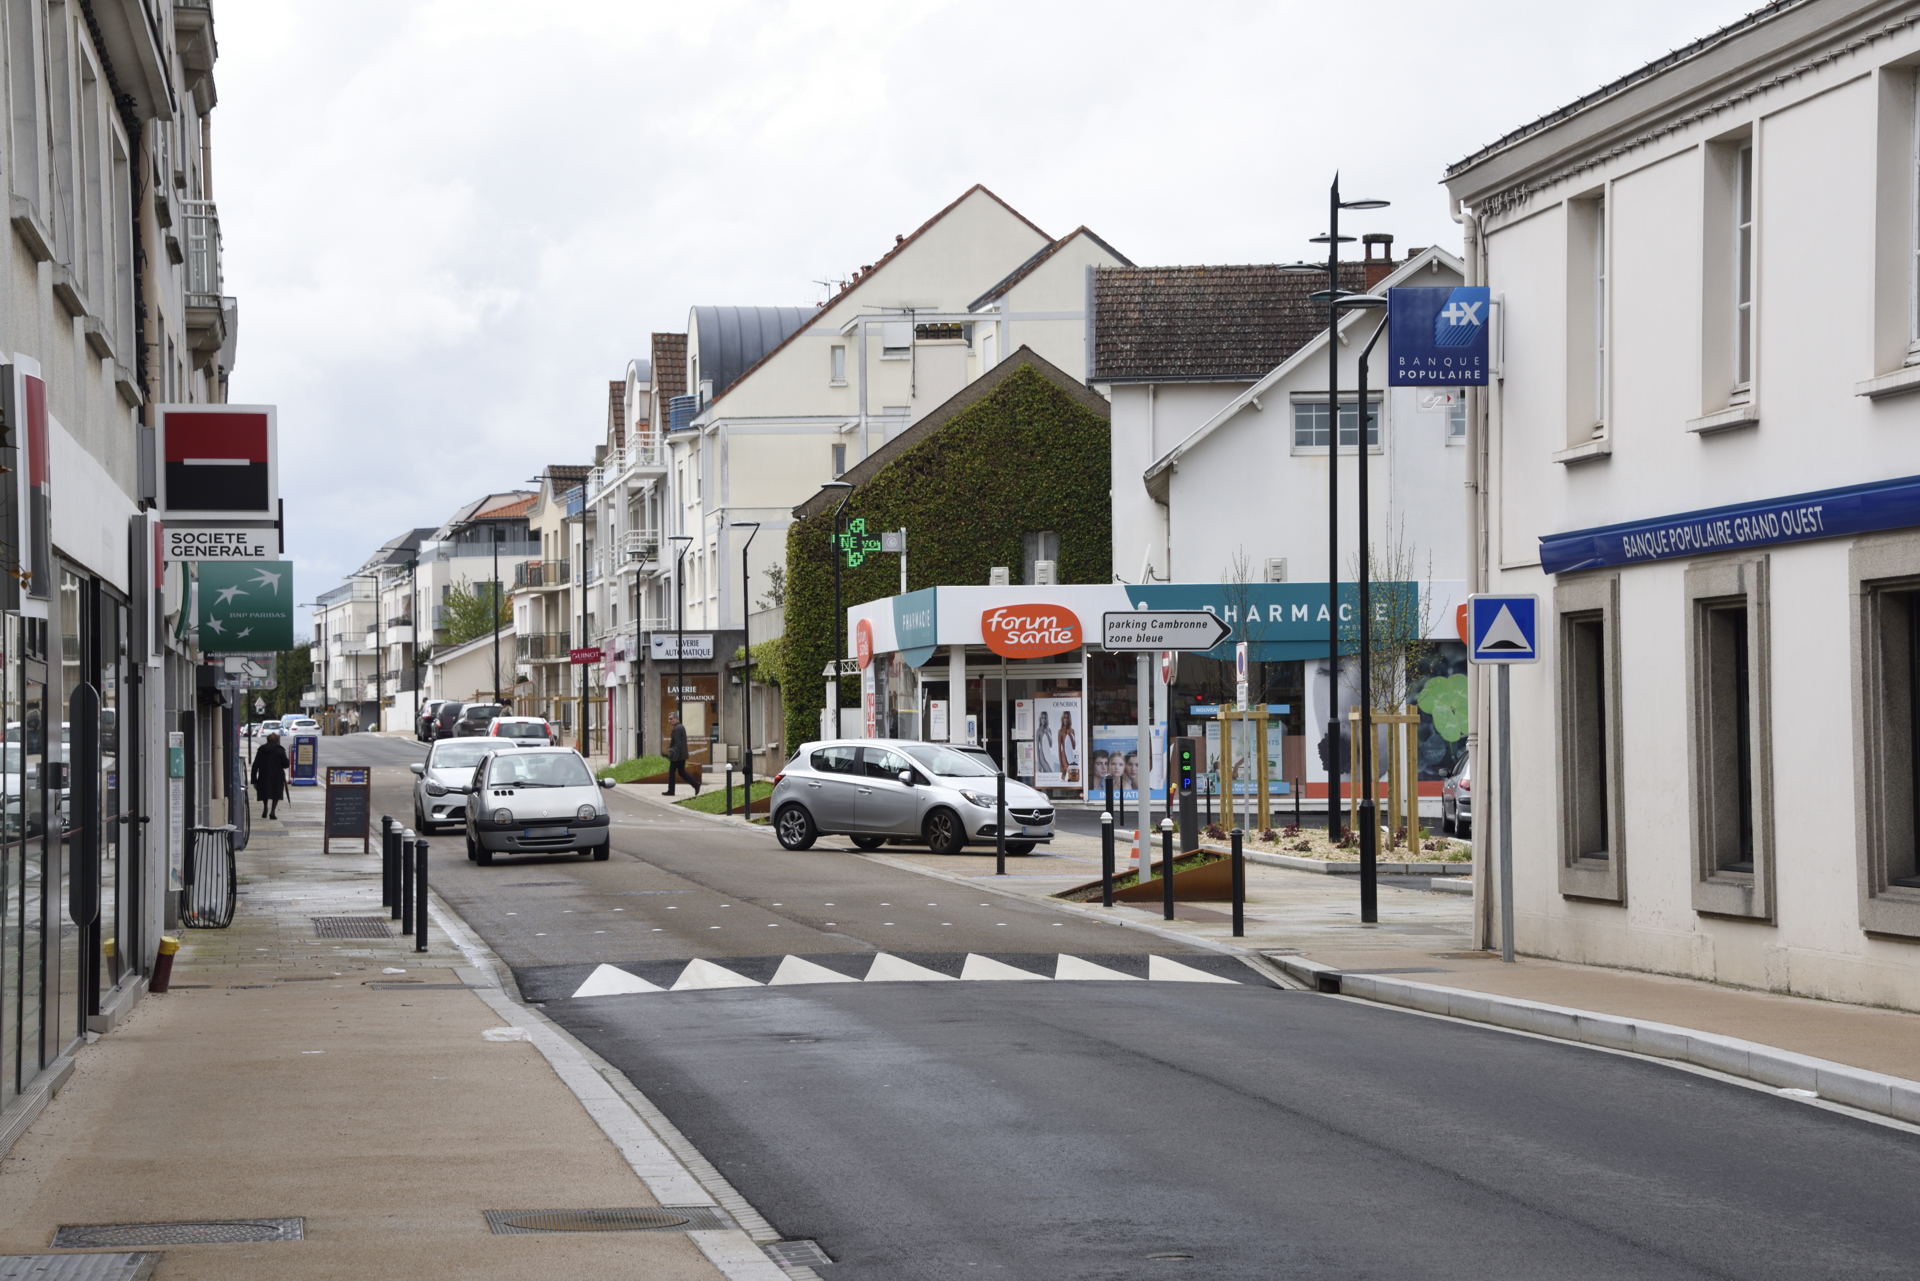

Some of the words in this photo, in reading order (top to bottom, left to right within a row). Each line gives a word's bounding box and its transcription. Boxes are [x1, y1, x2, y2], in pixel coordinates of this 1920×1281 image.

[1399, 357, 1480, 367] BANQUE
[1399, 370, 1481, 379] POPULAIRE
[1622, 530, 1670, 559] BANQUE
[1668, 519, 1734, 552] POPULAIRE
[1733, 512, 1779, 543] GRAND
[1781, 505, 1825, 536] OUEST
[171, 533, 248, 544] SOCIETE
[171, 545, 265, 557] GENERALE
[902, 609, 931, 632] PHARMACIE
[986, 609, 1058, 633] forum
[1108, 619, 1148, 632] parking
[1150, 619, 1208, 630] Cambronne
[1004, 624, 1076, 645] santé
[1108, 635, 1133, 643] zone
[1136, 632, 1164, 643] bleue
[571, 651, 599, 660] GUINOT
